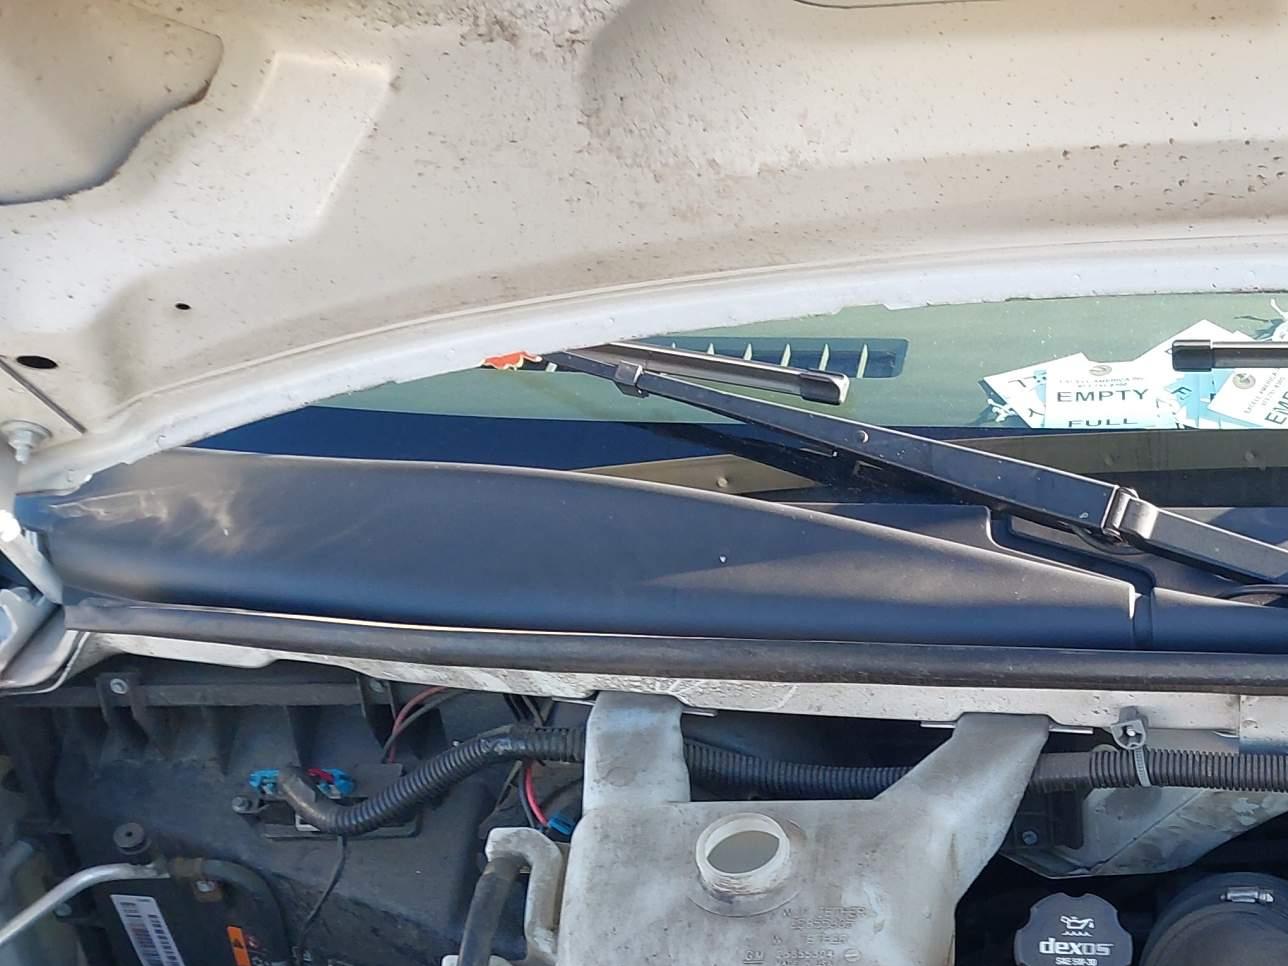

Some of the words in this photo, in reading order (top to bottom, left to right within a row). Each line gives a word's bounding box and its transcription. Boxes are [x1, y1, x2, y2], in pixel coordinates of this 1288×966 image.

[1057, 388, 1148, 403] EMPTY
[1068, 418, 1138, 428] FULL
[1039, 937, 1115, 956] dexos
